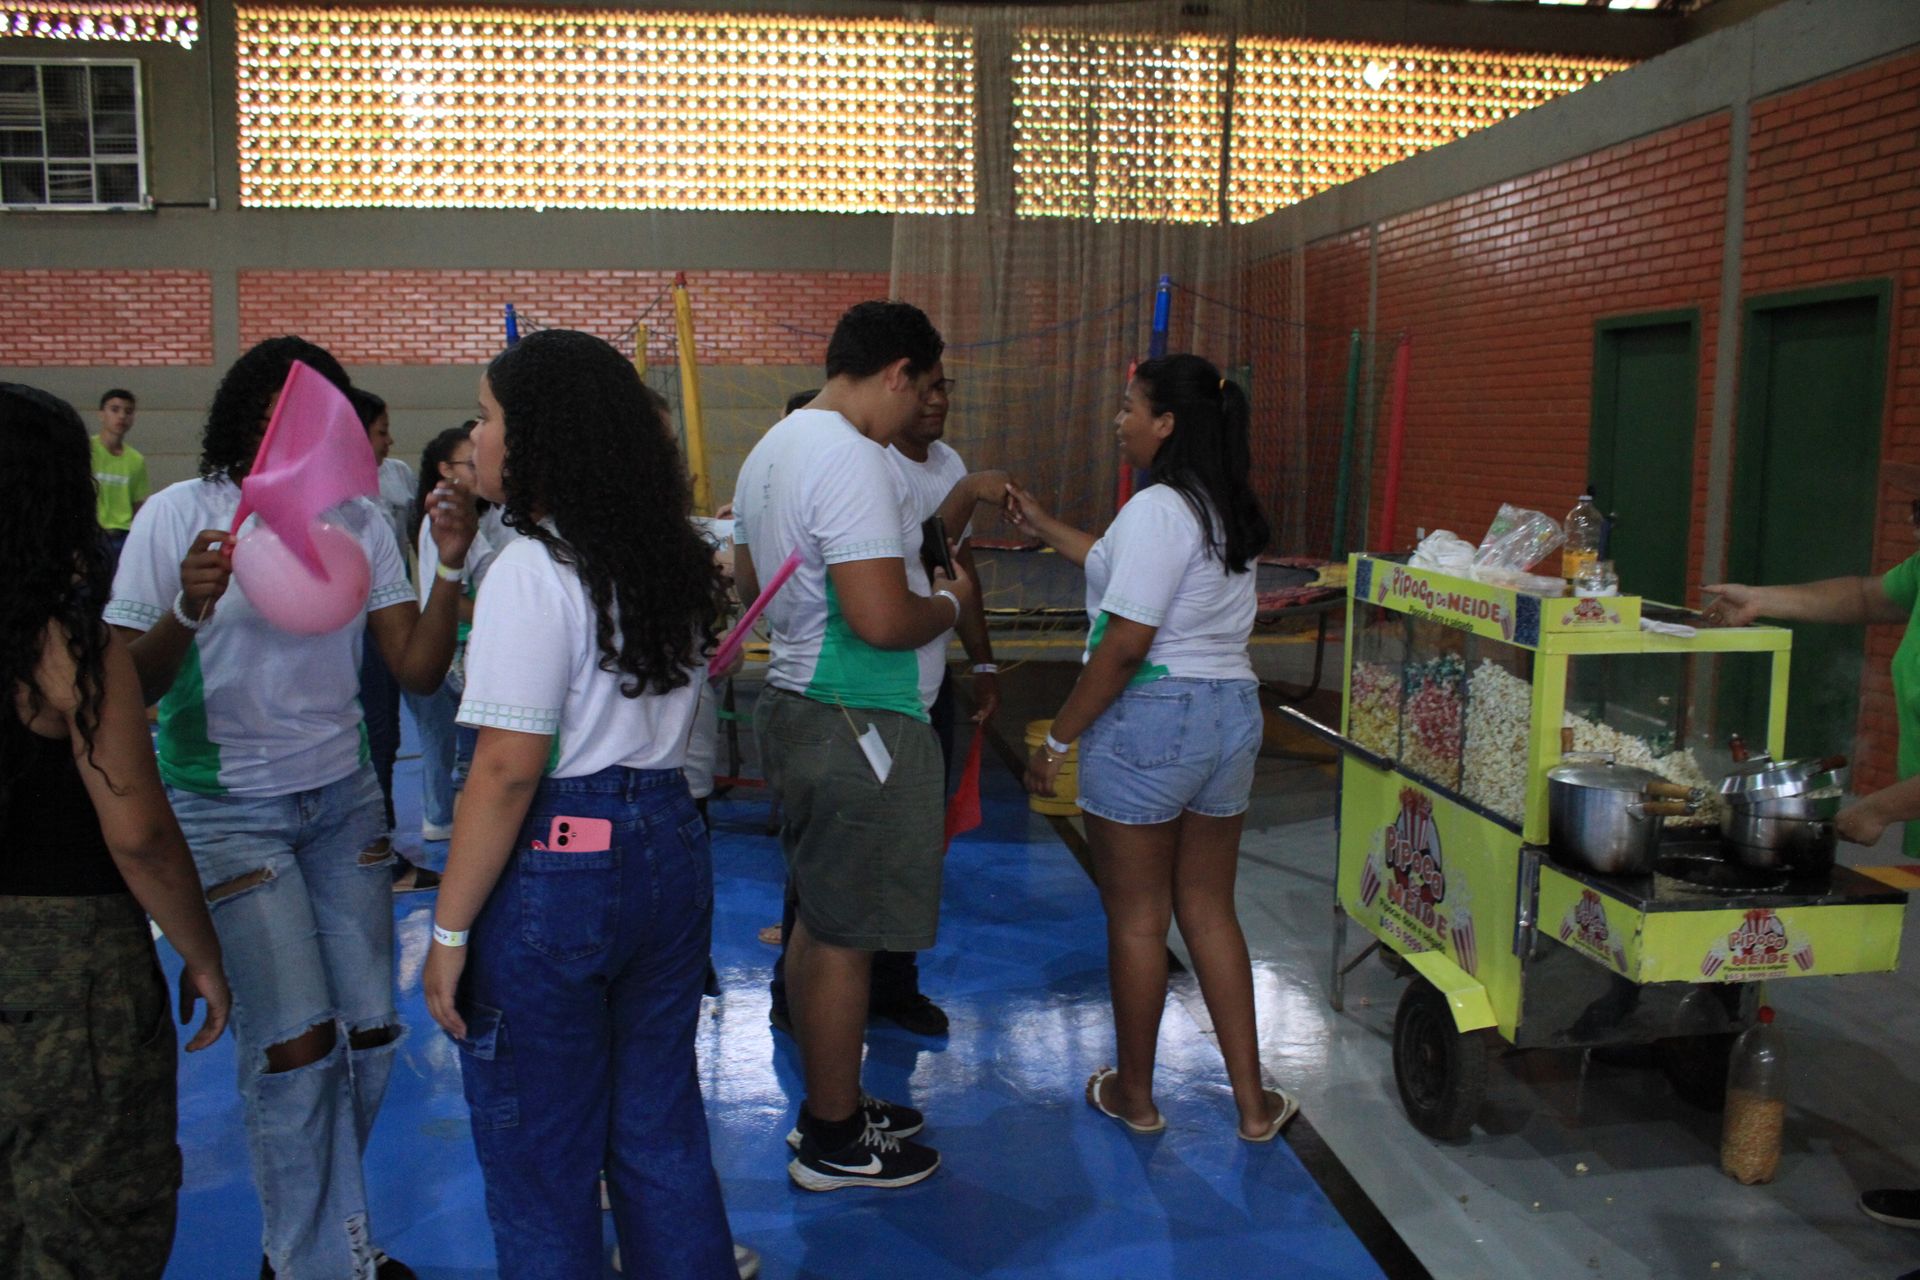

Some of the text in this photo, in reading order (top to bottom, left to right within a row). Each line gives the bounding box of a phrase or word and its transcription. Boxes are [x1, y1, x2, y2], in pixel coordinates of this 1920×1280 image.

[1447, 592, 1501, 623] NEIDE
[1387, 878, 1448, 941] NEIDE
[1731, 952, 1790, 966] NEIDE
